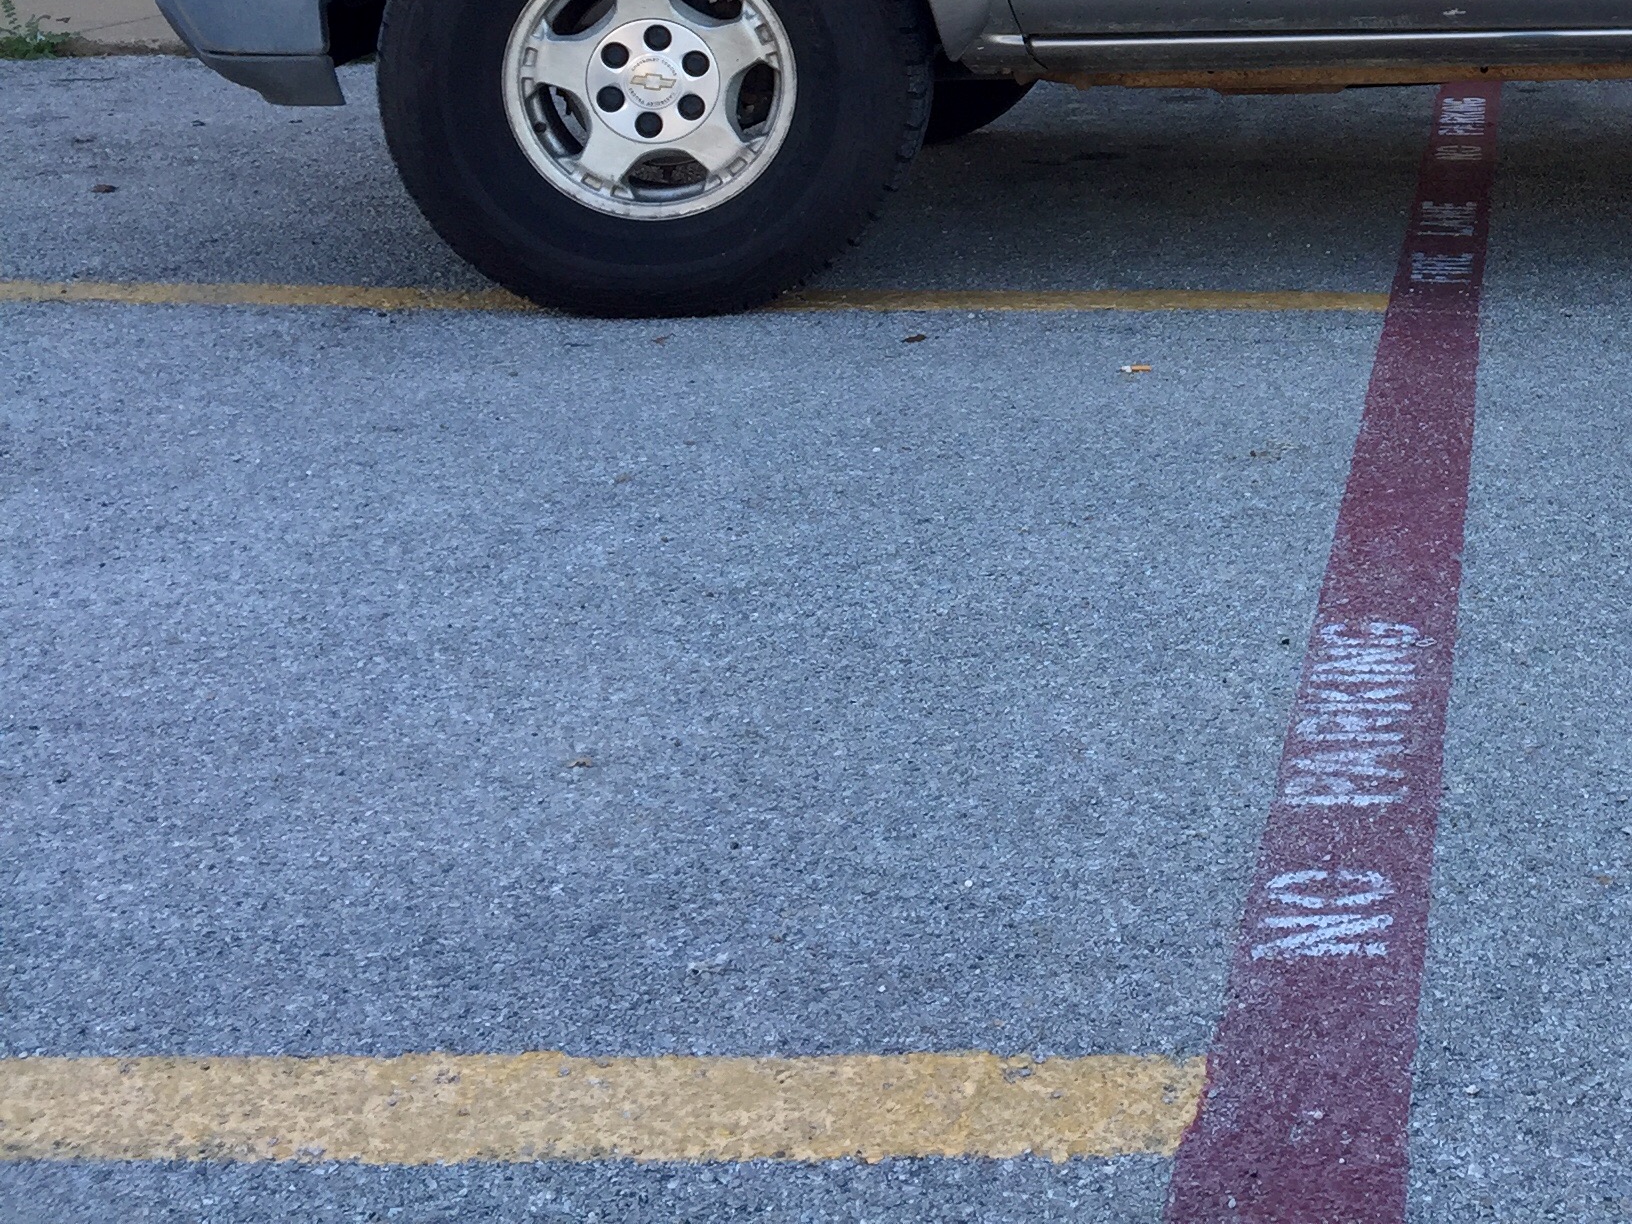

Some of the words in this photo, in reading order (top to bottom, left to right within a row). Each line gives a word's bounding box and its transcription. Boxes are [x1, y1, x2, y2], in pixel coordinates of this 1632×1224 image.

[1434, 144, 1483, 161] NO
[1416, 200, 1478, 237] LANE
[1410, 252, 1474, 284] FIRE
[1283, 621, 1421, 806] PARKING
[1250, 869, 1395, 960] NO
